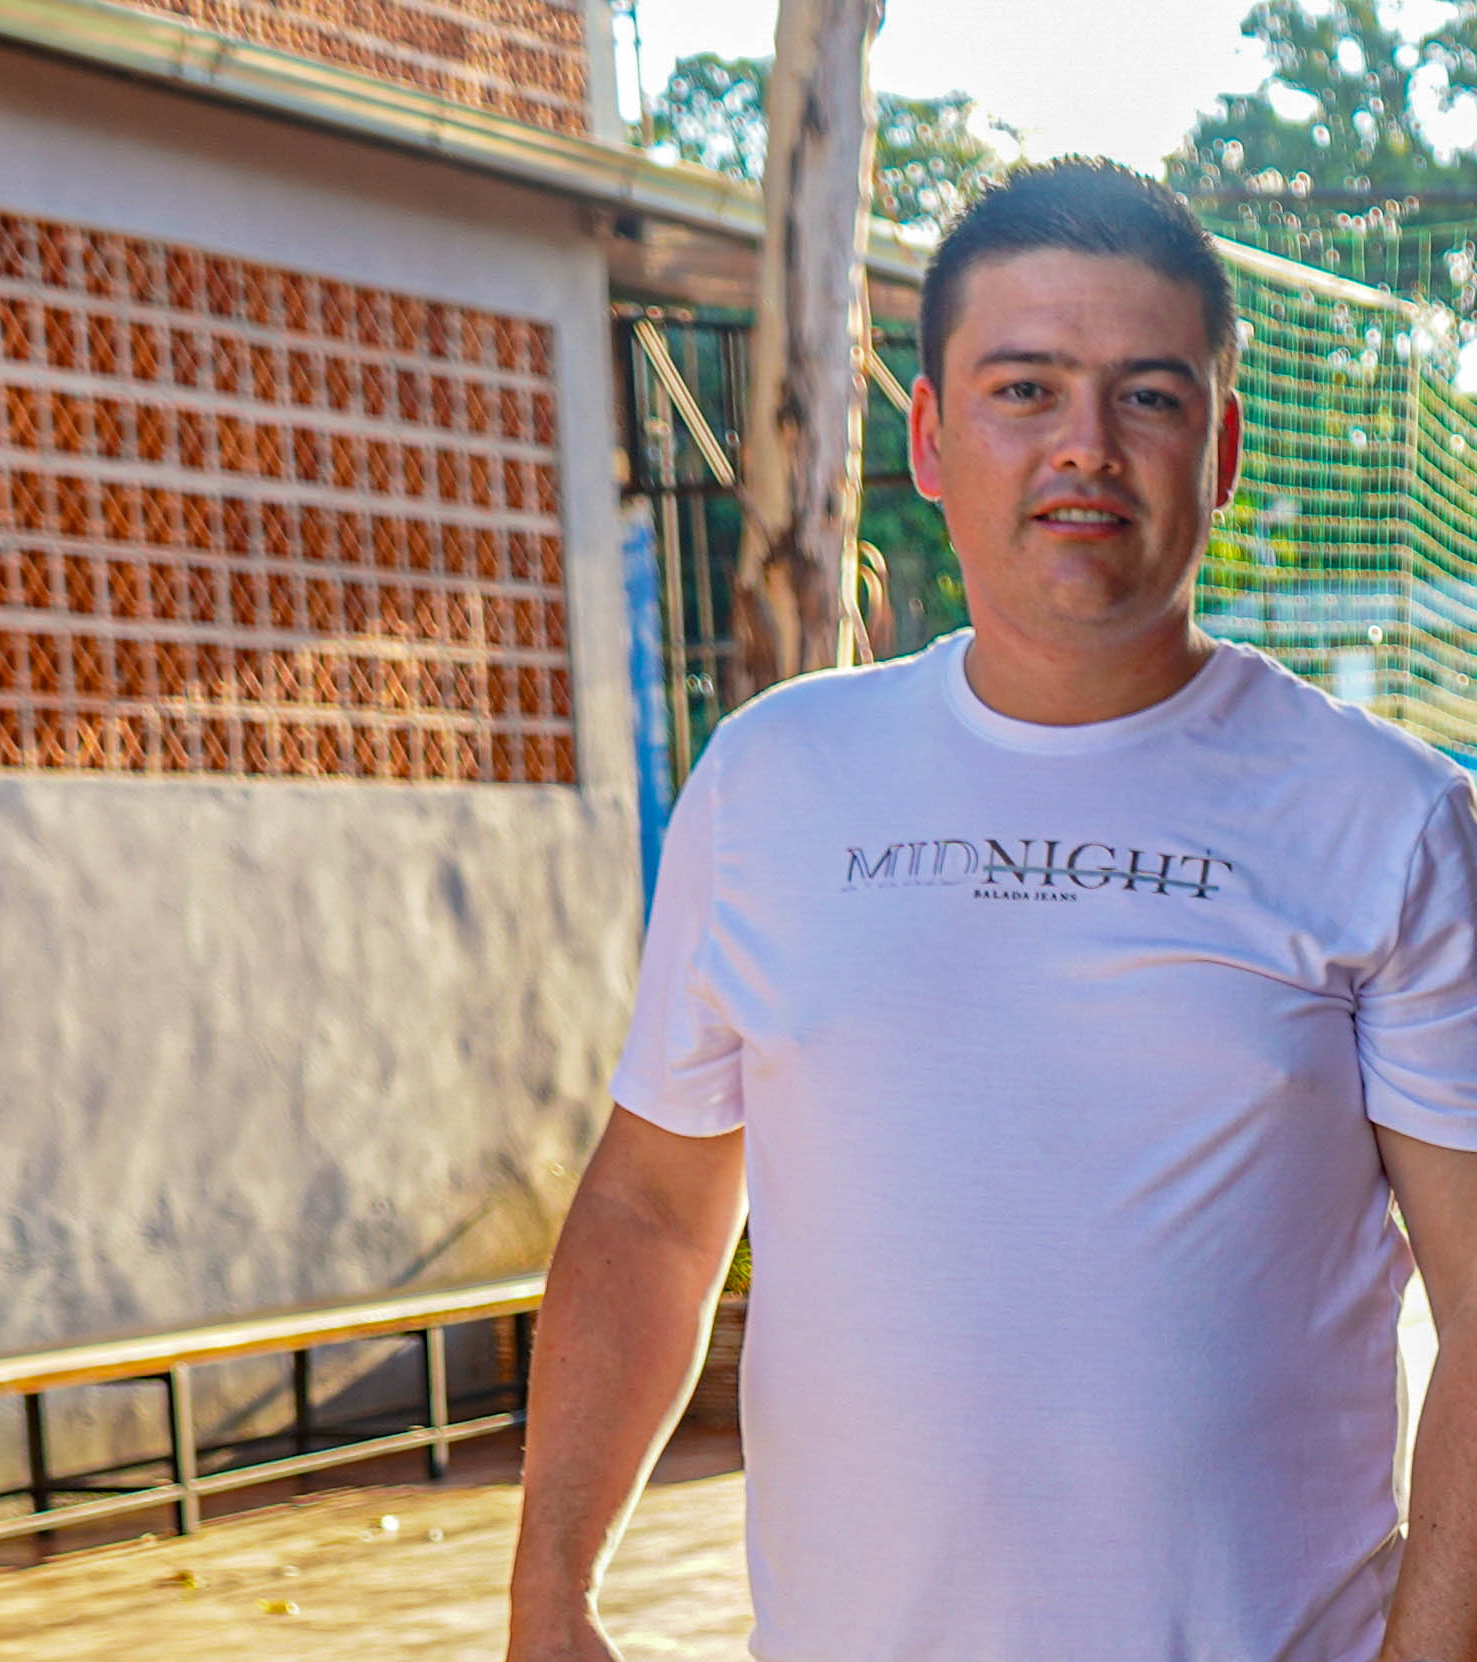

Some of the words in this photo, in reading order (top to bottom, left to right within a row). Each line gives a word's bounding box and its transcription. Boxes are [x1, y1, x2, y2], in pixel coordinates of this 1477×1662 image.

[844, 838, 1233, 900] MIDNIGHT
[973, 889, 1030, 901] BALADA
[1034, 892, 1078, 902] JEANS
